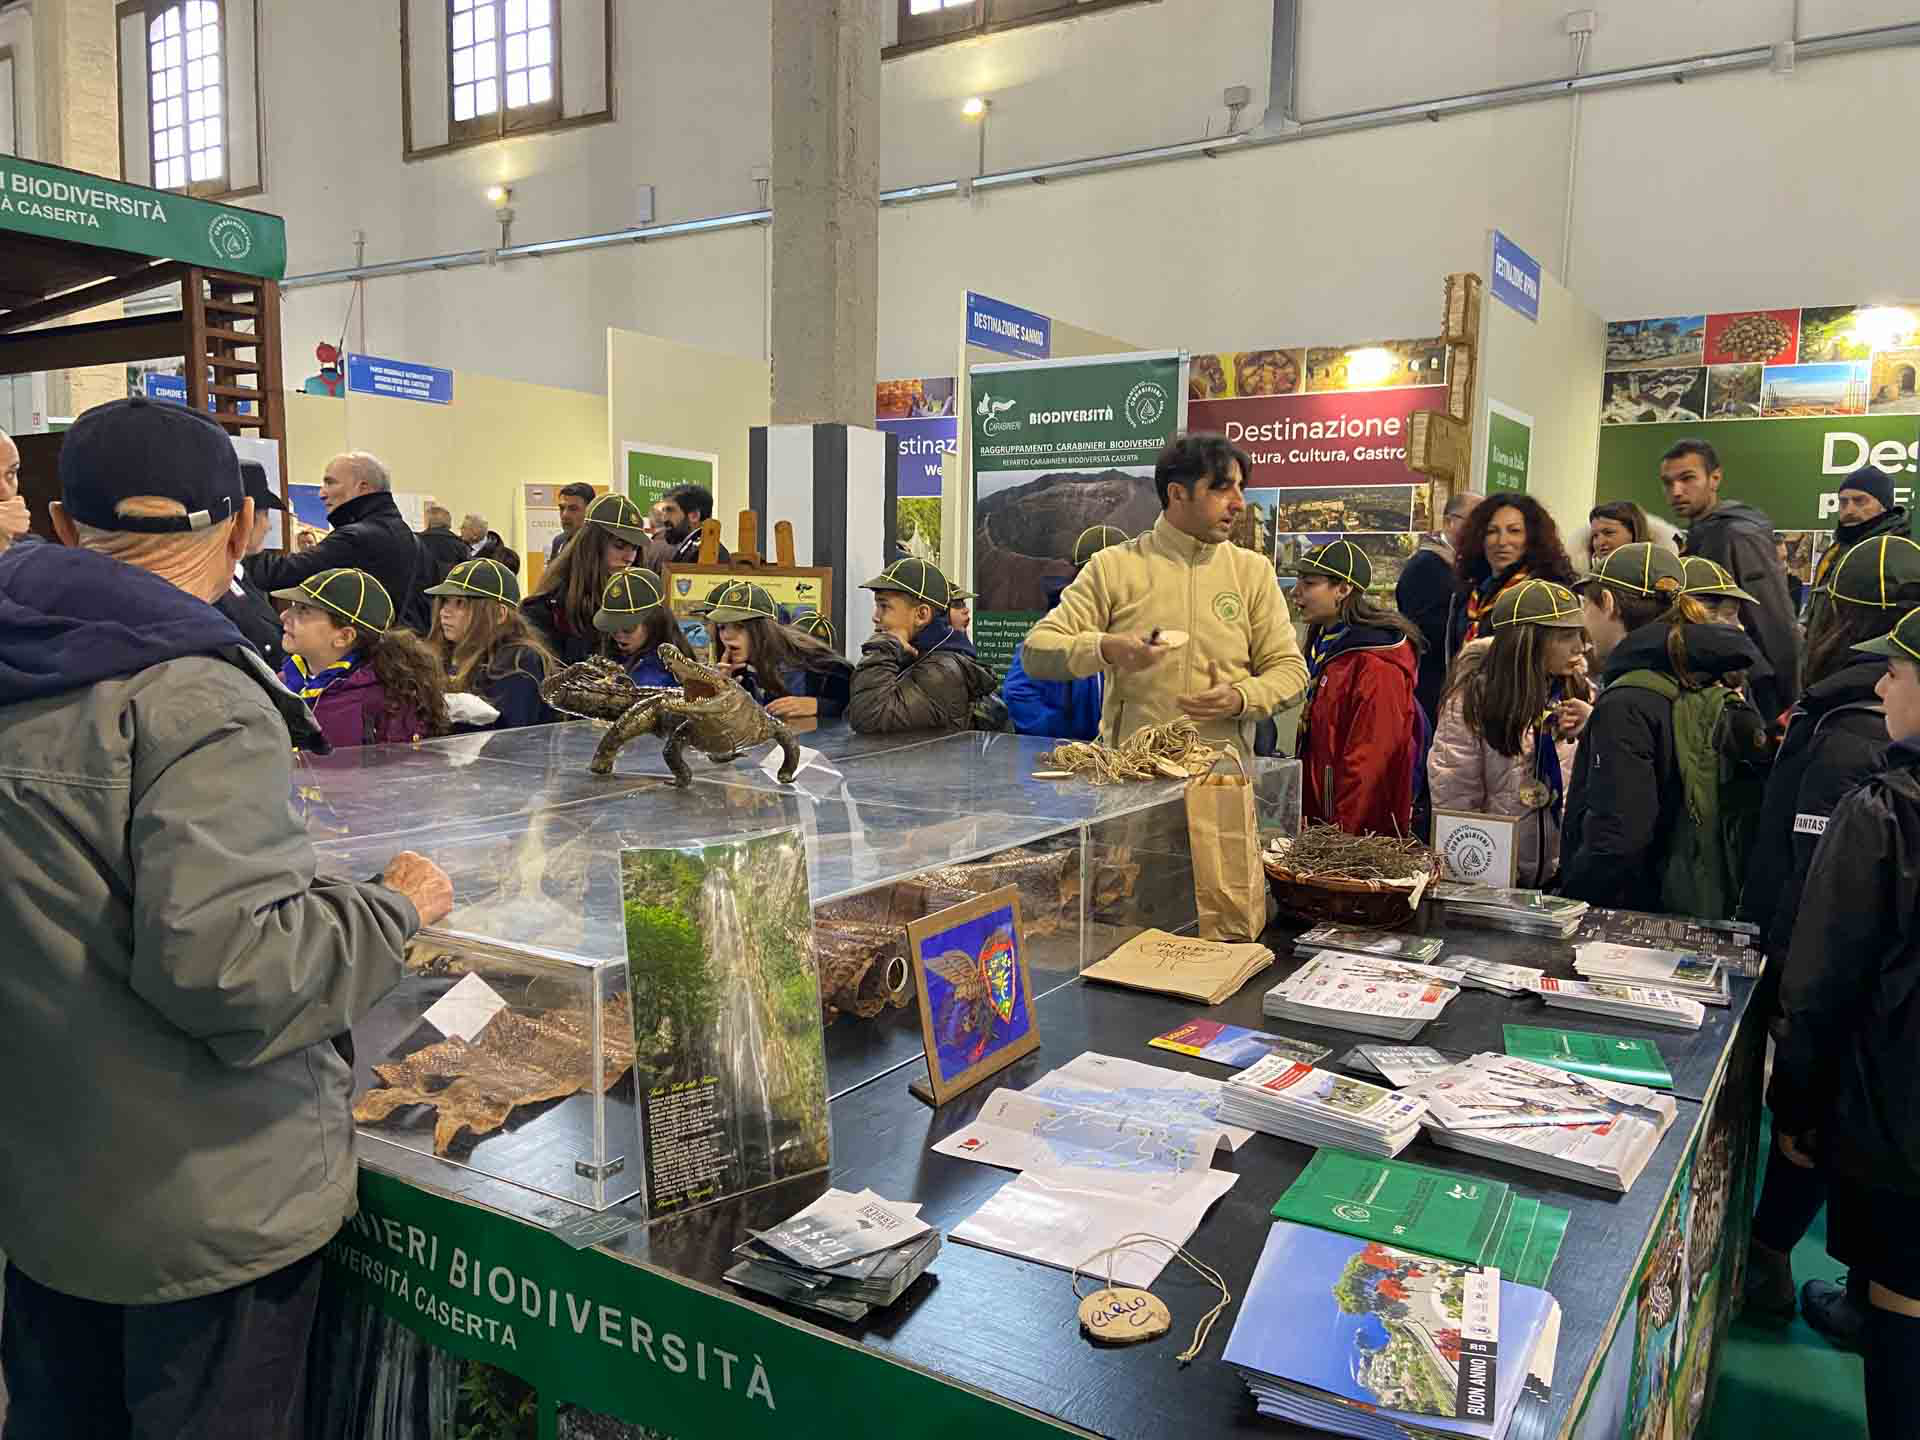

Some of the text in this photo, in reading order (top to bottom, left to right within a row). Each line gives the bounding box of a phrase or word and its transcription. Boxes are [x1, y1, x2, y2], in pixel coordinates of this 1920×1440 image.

[11, 173, 167, 223] BIODIVERSITÀ
[17, 200, 100, 228] CASERTA
[974, 311, 1044, 346] DESTINAZIONE SANNIO
[1029, 405, 1113, 425] BIODIVERSITÀ
[1224, 414, 1401, 443] Destinazione
[980, 437, 1165, 455] RAGGRUPPAMENTO CARABINIERI BIODIVERSITÀ
[1030, 457, 1067, 466] CARABINIERI
[1068, 455, 1110, 464] BIODIVERSITÀ
[1111, 454, 1138, 462] CASERTA
[1288, 447, 1350, 463] Cultura,
[639, 473, 671, 488] Ritorno
[414, 1286, 517, 1351] CASERTA
[449, 1247, 776, 1410] BIODIVERSITÀ
[1469, 1358, 1488, 1388] ANNO
[1467, 1387, 1486, 1416] BUON
